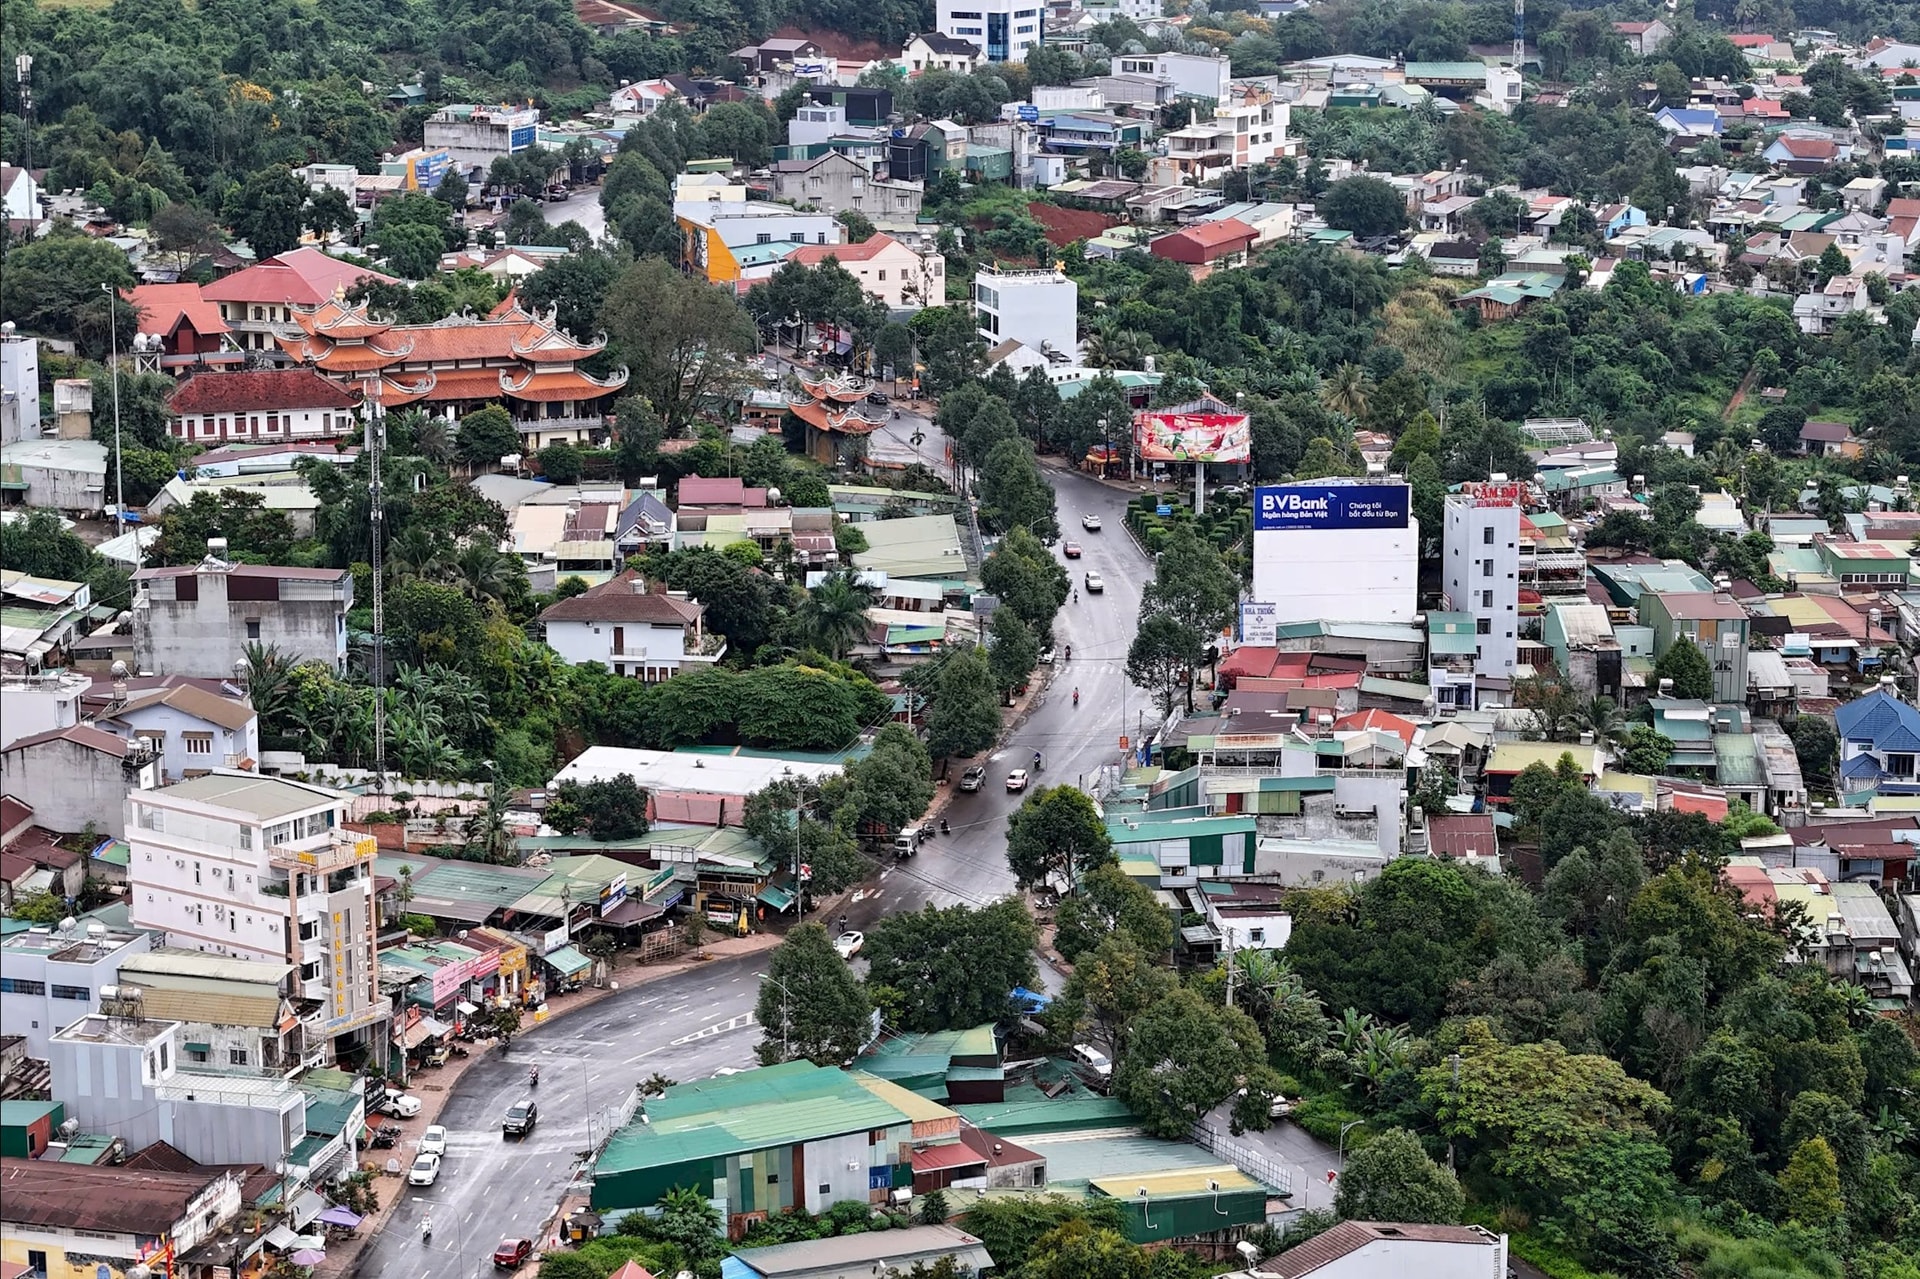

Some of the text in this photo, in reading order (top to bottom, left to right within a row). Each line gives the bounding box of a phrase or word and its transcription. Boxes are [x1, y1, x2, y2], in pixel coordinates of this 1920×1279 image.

[1262, 495, 1328, 510] BVBank
[1349, 502, 1371, 510] Chúng
[1282, 511, 1299, 519] hàng
[1315, 511, 1328, 519] Việt
[356, 932, 365, 997] HOTEL
